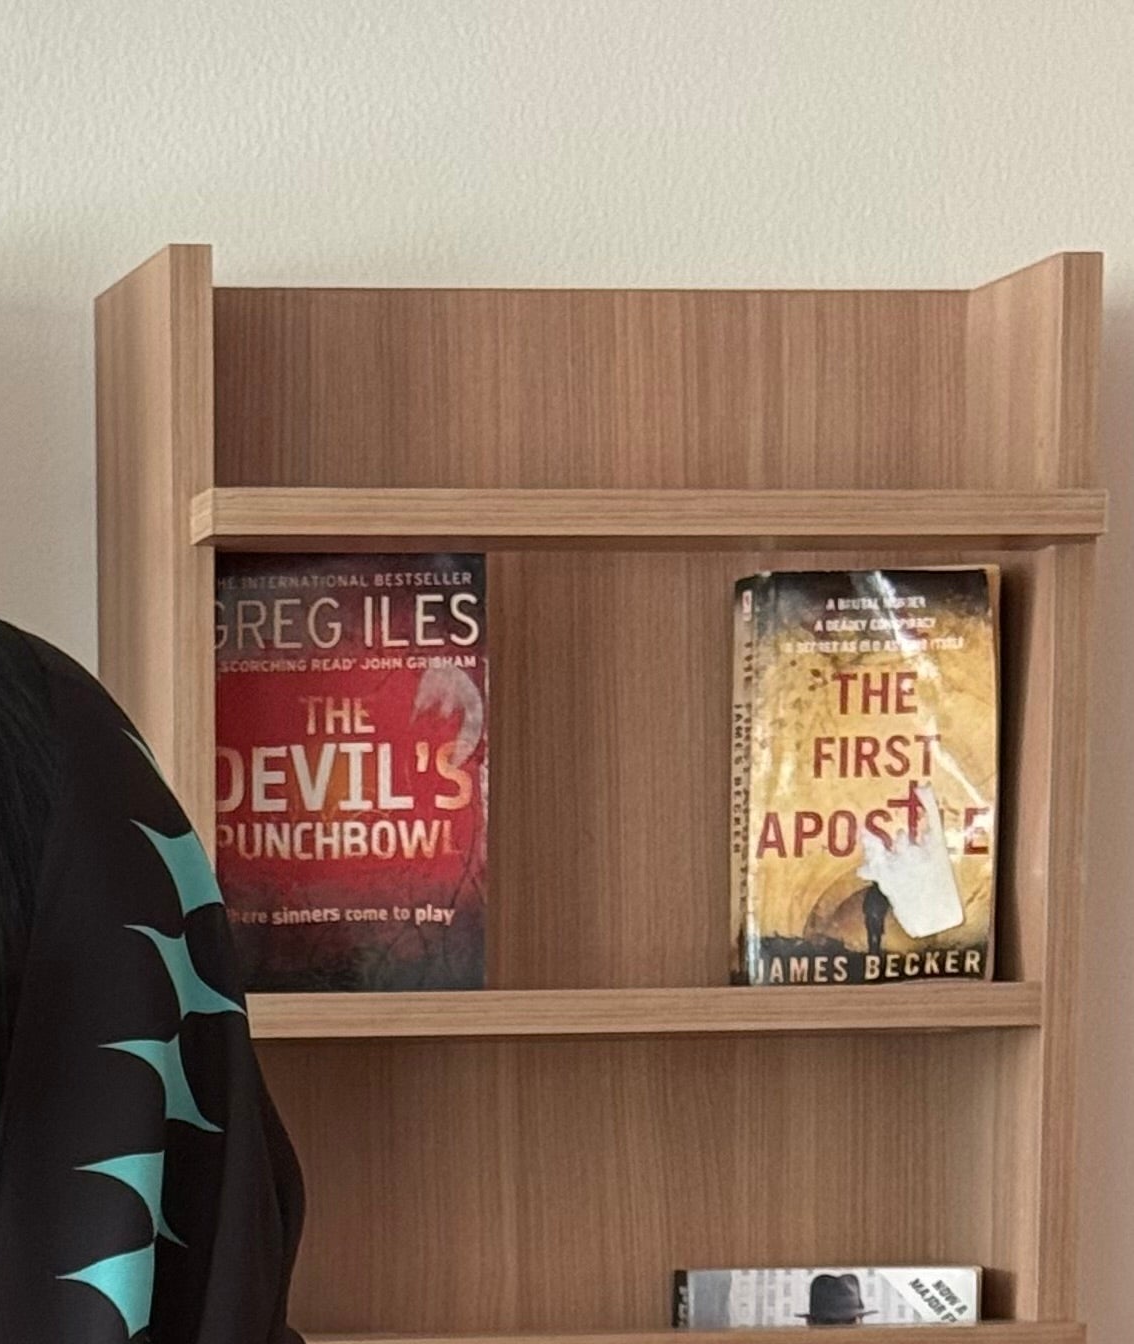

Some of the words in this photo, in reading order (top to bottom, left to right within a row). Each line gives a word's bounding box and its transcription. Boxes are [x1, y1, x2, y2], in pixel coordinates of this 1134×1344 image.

[241, 574, 368, 590] INTERNATIONAL
[373, 571, 473, 587] BESTSELLER
[363, 592, 480, 648] ILES
[219, 658, 308, 674] SCORCHING
[360, 656, 403, 671] JOHN
[406, 655, 478, 670] GRISHAM
[832, 670, 919, 716] THE
[298, 695, 376, 736] THE
[215, 739, 473, 813] DEVIL'S
[813, 733, 942, 779] FIRST
[755, 779, 991, 859] APOSTE
[226, 907, 268, 925] here
[271, 906, 340, 927] sinners
[345, 908, 389, 922] come
[393, 905, 411, 922] to
[415, 903, 456, 927] play
[754, 954, 849, 985] JAMES
[865, 949, 982, 982] BECKER
